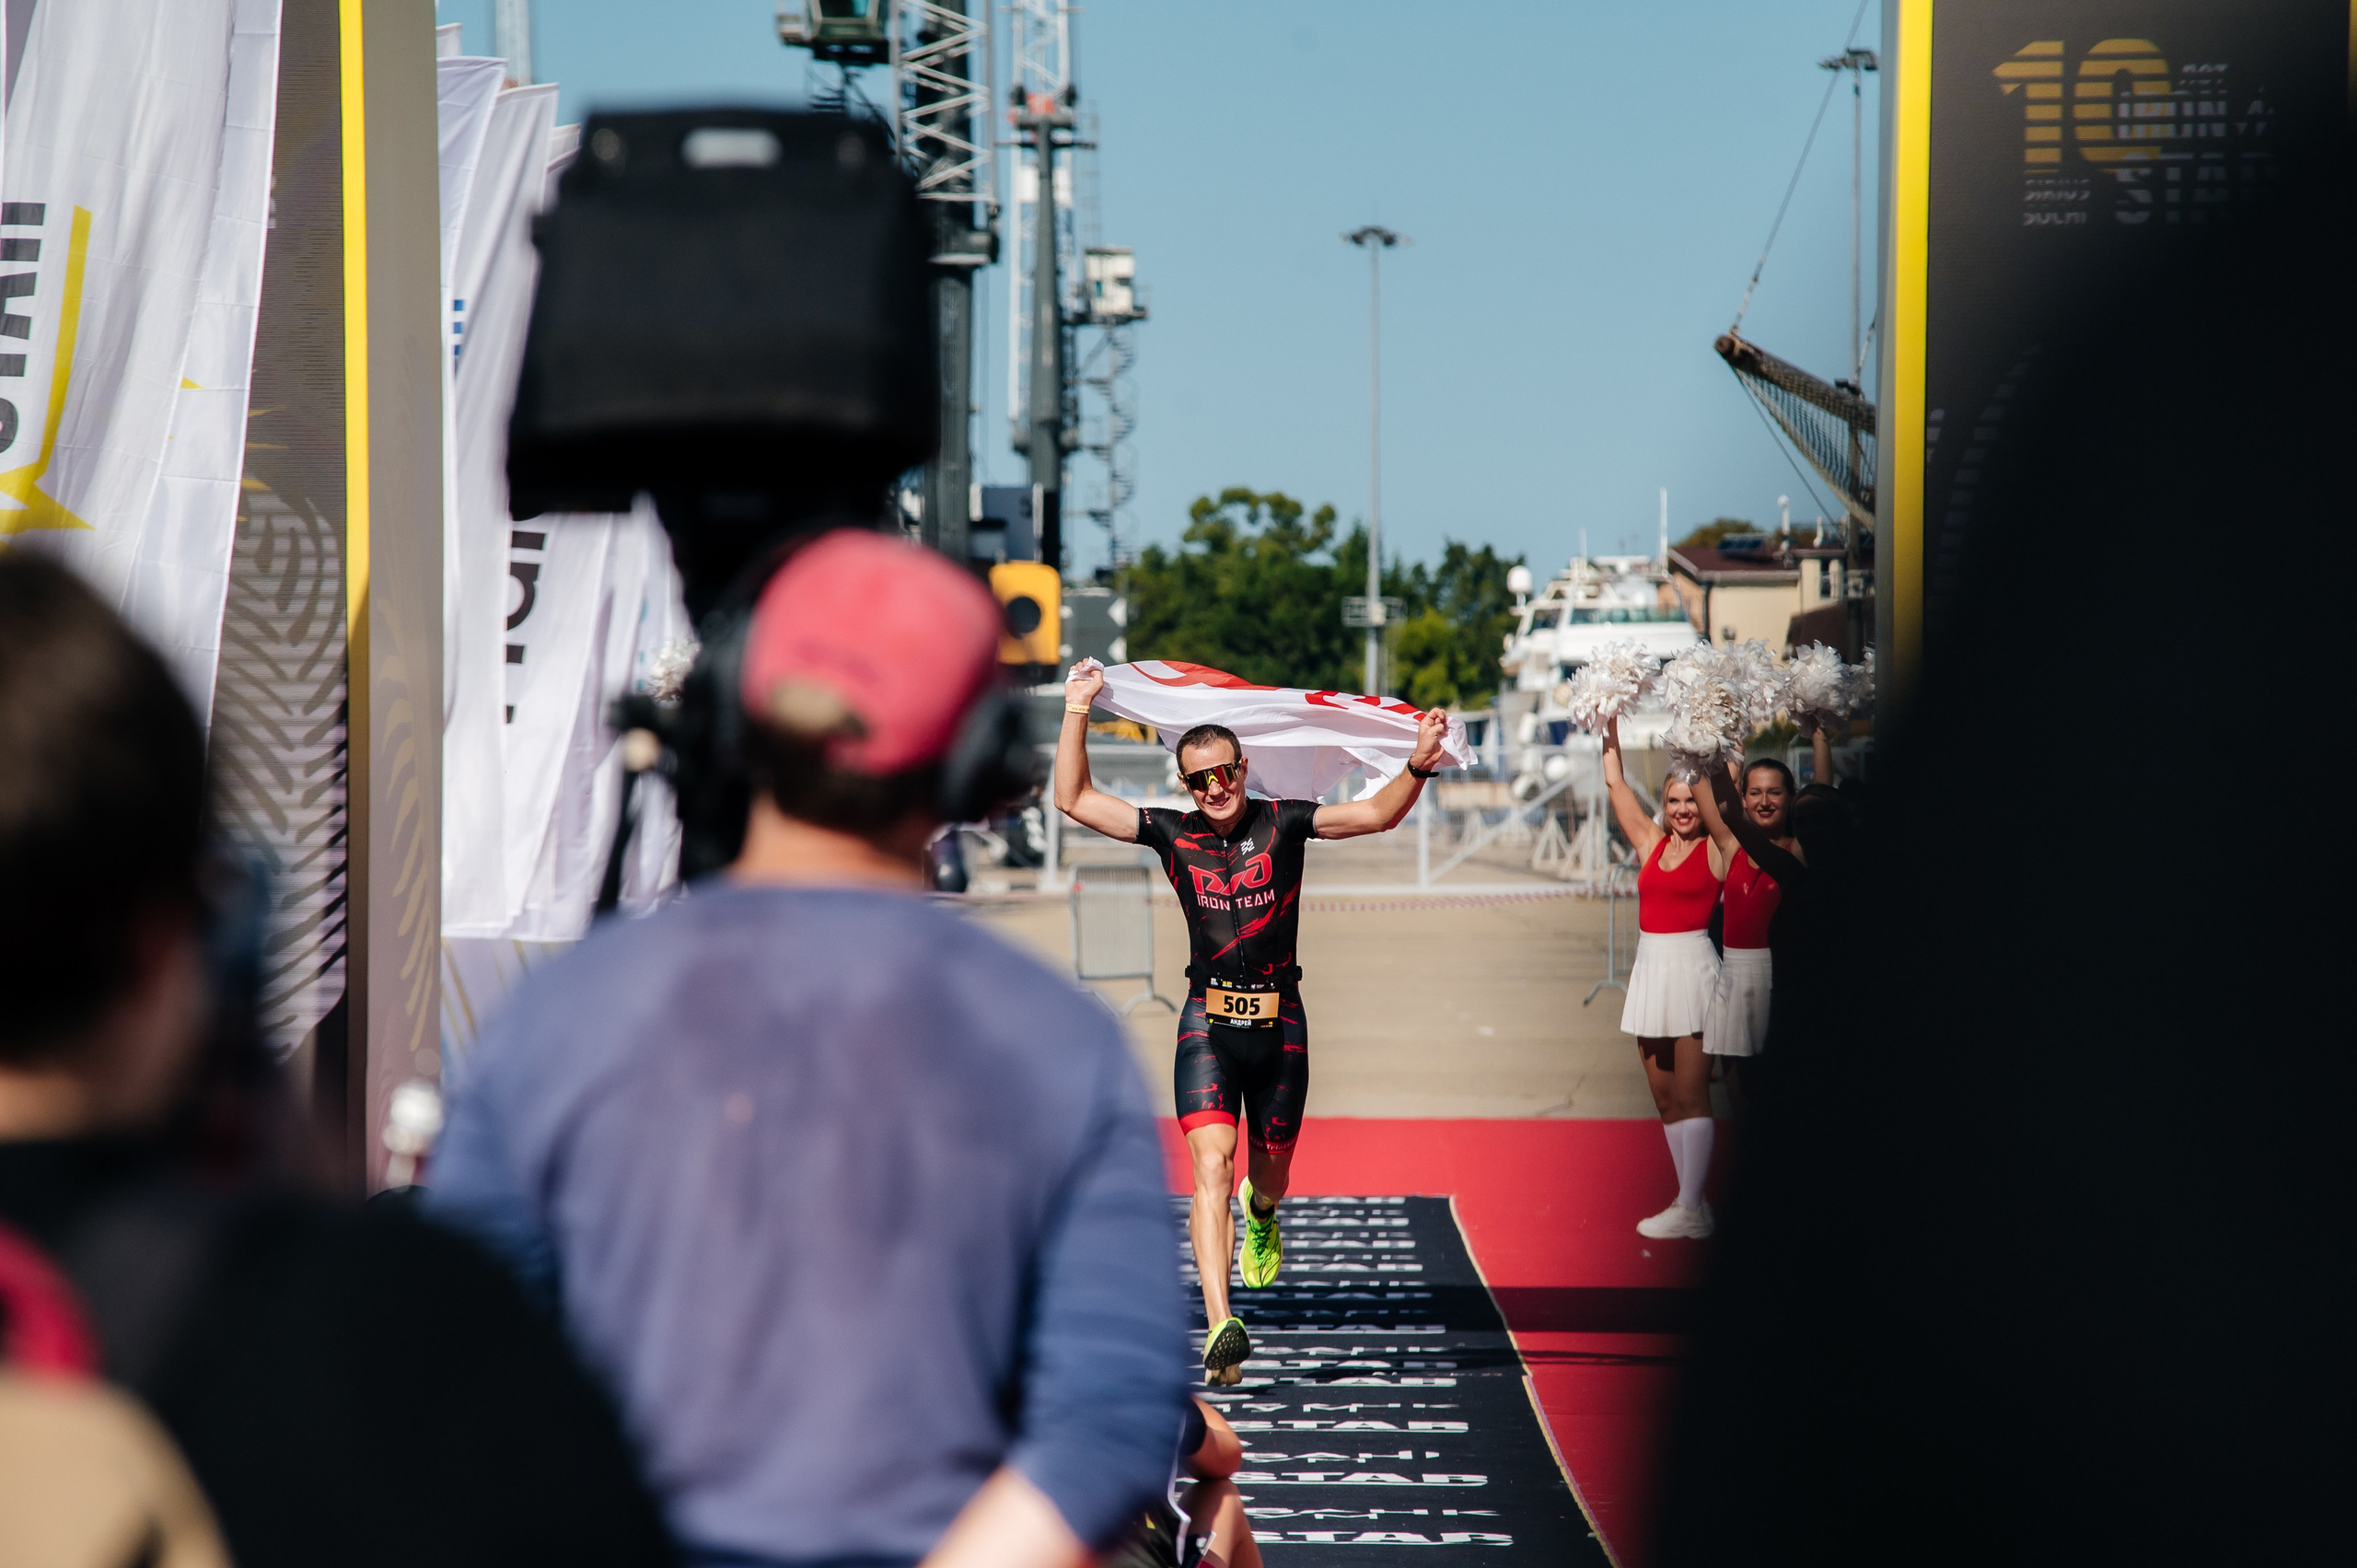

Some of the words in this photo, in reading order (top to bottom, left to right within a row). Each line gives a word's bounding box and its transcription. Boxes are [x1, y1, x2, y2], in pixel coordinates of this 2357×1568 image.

[1991, 38, 2171, 174] 10
[1197, 893, 1231, 912] IRON
[1235, 889, 1275, 909] TEAM
[1224, 995, 1260, 1016] 505
